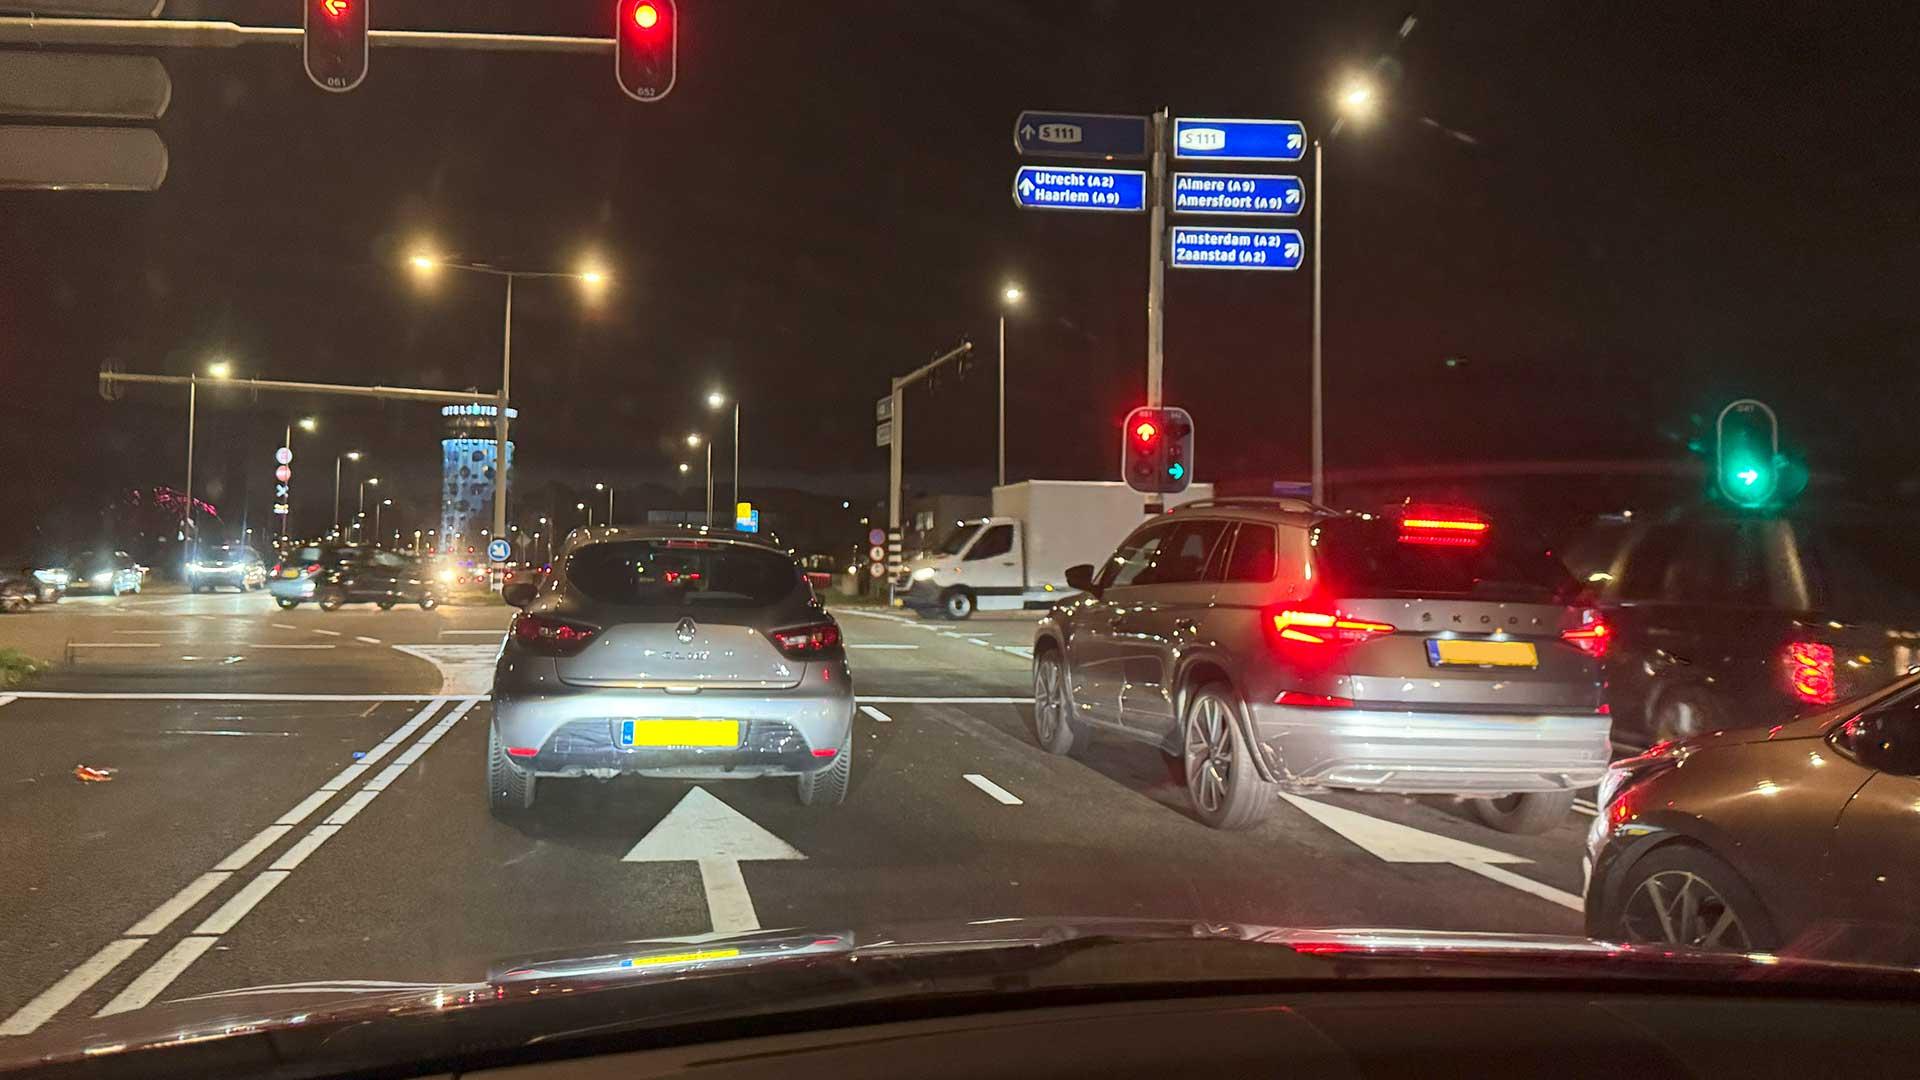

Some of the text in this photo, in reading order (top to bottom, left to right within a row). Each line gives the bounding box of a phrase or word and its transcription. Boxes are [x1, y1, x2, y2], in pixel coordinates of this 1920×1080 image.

[1043, 127, 1074, 139] S 111
[1185, 133, 1216, 144] S 111
[1035, 172, 1114, 189] Utrecht (A2)
[1178, 178, 1256, 194] Almere (A9)
[1035, 188, 1120, 205] Haarlem (A9)
[1177, 193, 1283, 211] Amersfoort (A9)
[1176, 231, 1281, 249] Amsterdam (A2)
[1176, 247, 1266, 265] Zaanstad (A2)
